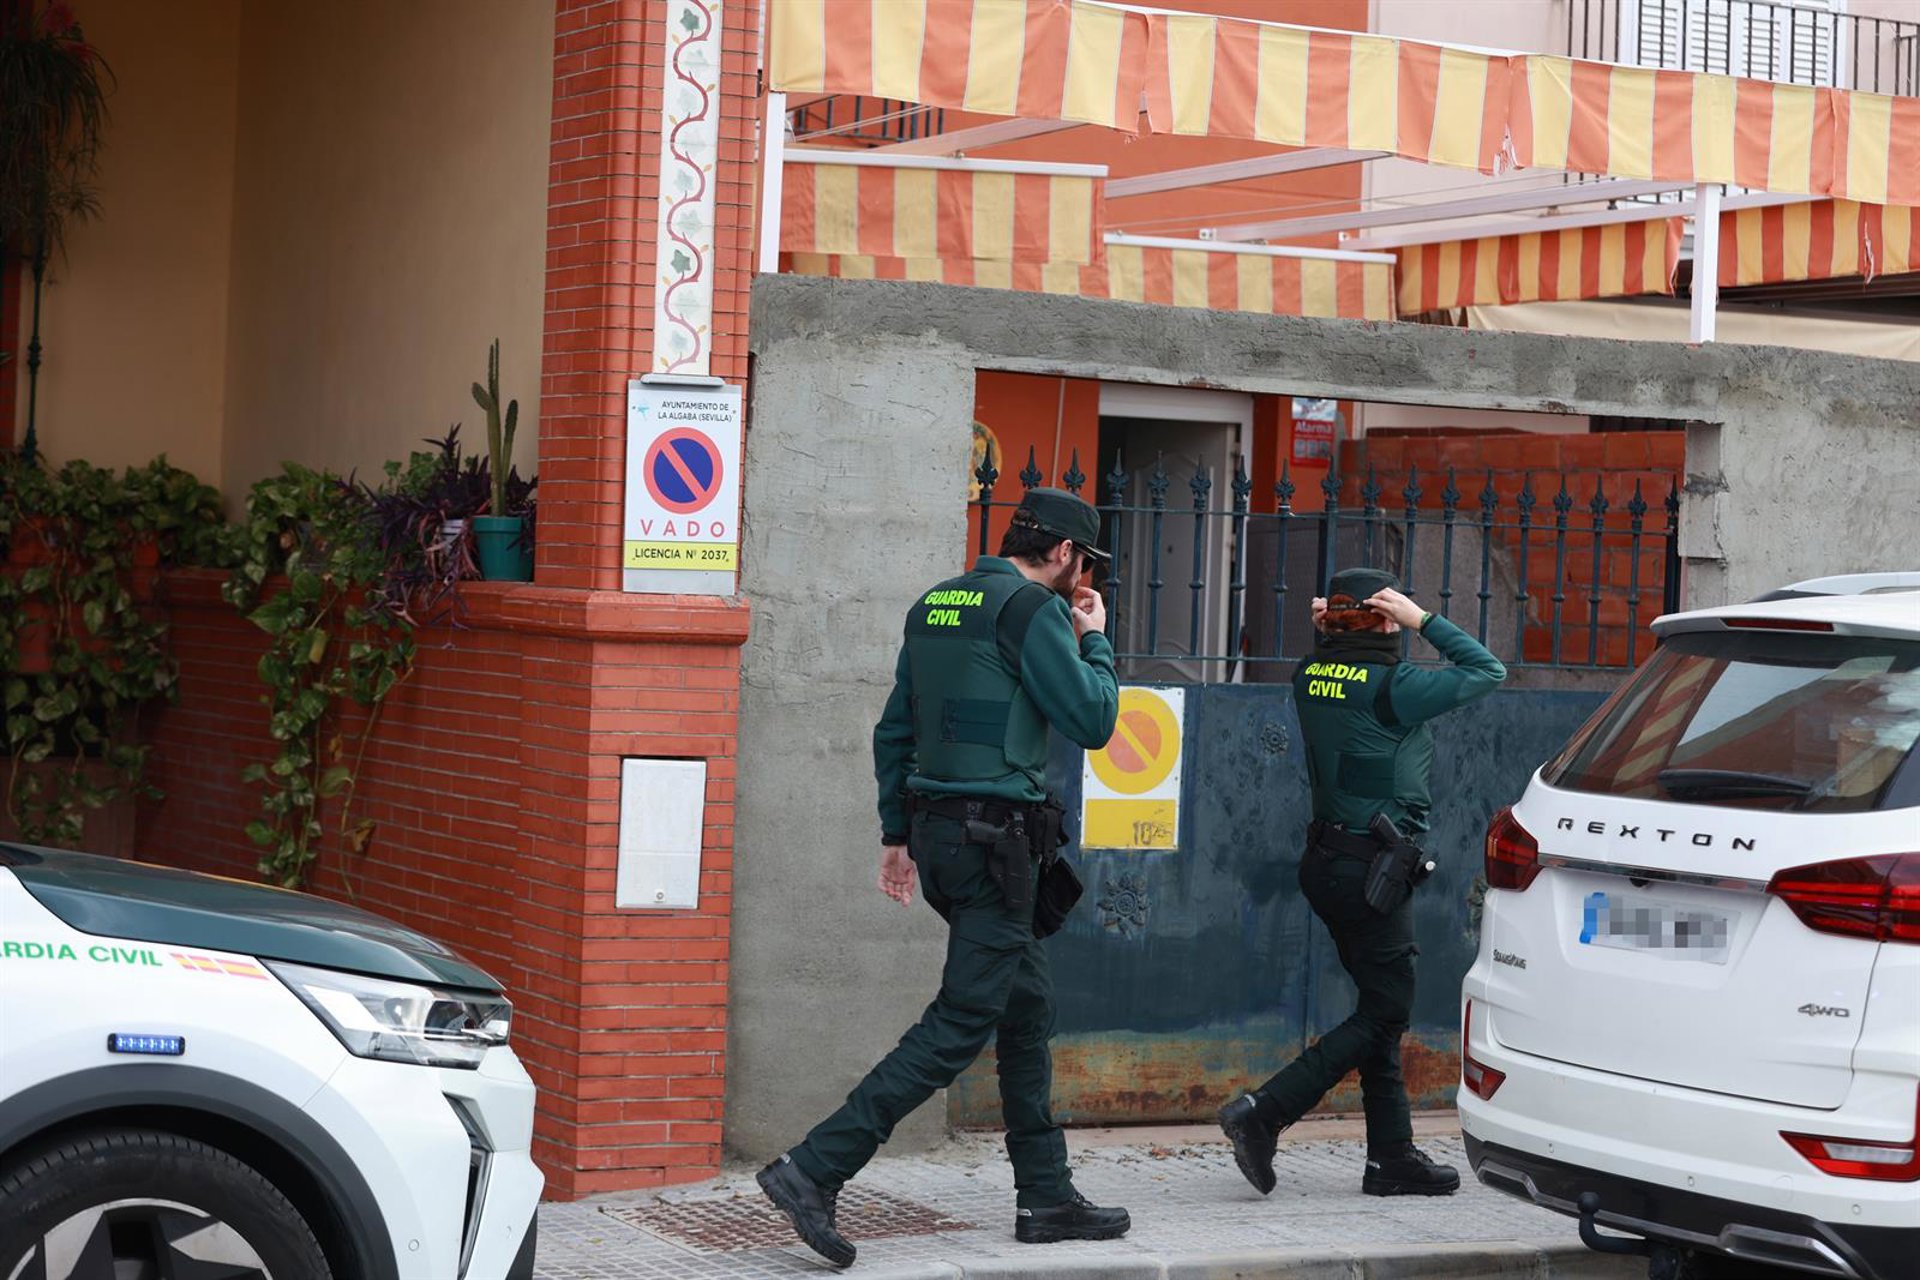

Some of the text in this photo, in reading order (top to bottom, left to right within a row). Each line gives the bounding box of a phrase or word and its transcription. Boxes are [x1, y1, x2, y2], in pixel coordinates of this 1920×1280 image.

[661, 400, 729, 411] AYUNTAMIENTO DE
[658, 411, 732, 422] LA ALGABA (SEVILLA)
[640, 518, 725, 538] VADO
[634, 547, 681, 560] LICENCIA
[701, 550, 727, 561] 2037
[924, 589, 984, 607] GUARDIA
[926, 608, 961, 626] CIVIL
[1305, 662, 1368, 682] GUARDIA
[1308, 680, 1346, 699] CIVIL
[1557, 816, 1757, 851] REXTON
[0, 941, 163, 967] RDIA CIVIL
[1797, 1003, 1850, 1017] 4WD
